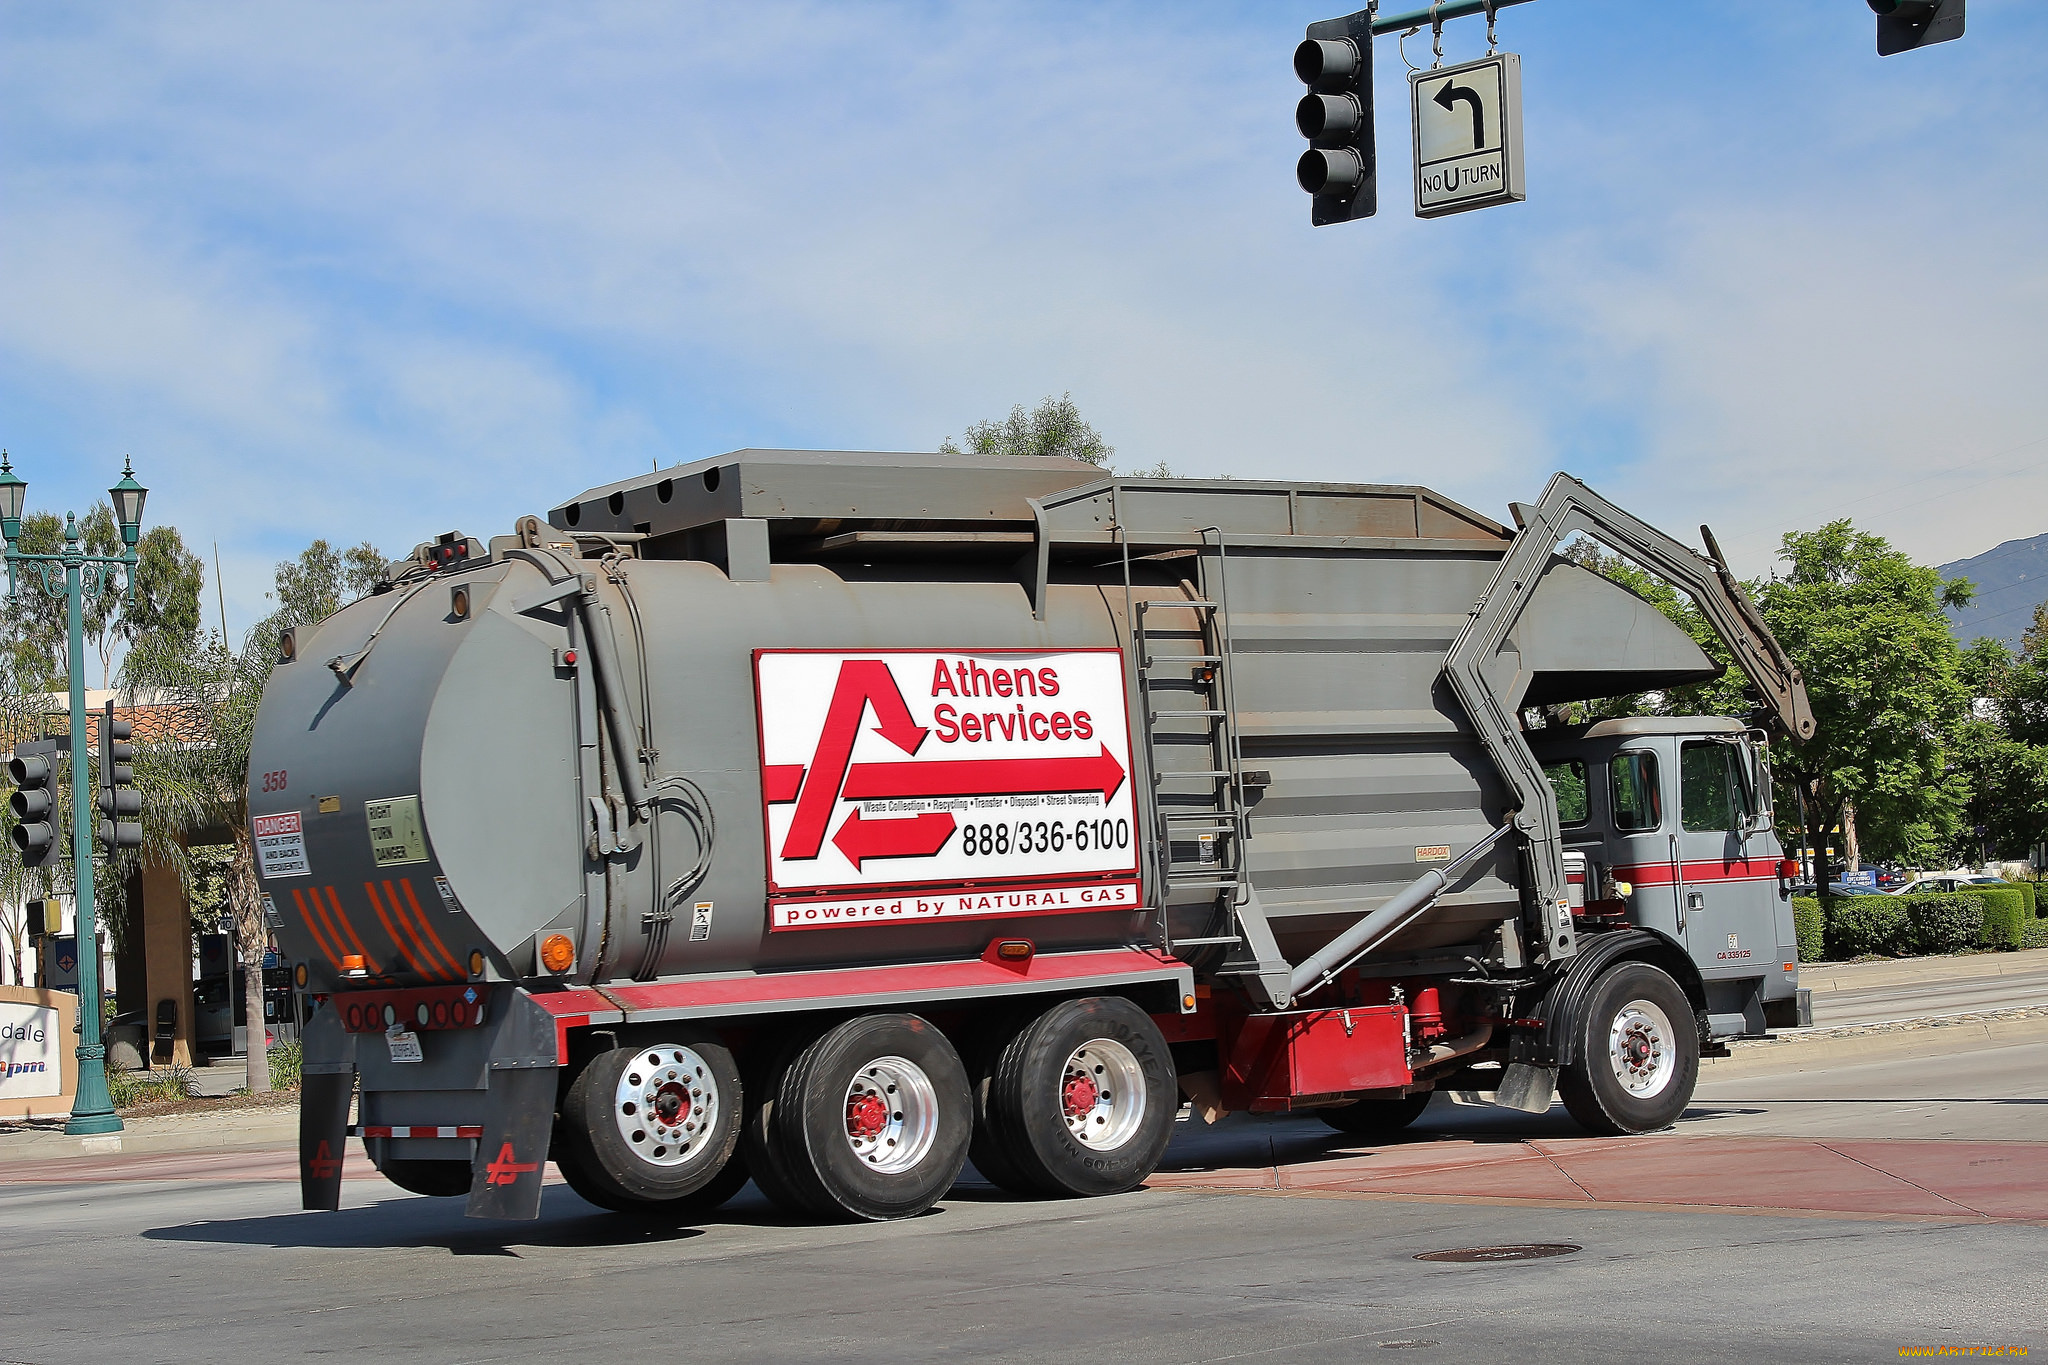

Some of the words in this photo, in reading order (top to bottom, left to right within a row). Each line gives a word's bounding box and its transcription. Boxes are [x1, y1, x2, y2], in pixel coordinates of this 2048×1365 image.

[1423, 175, 1442, 194] NO
[1443, 167, 1460, 193] U
[1461, 163, 1501, 186] TURN
[931, 658, 1060, 698] Athens
[934, 702, 1094, 744] Services
[262, 769, 288, 793] 358
[369, 804, 392, 820] RIGHT
[863, 801, 887, 813] Waste
[888, 800, 926, 812] Collection
[932, 798, 968, 812] Recycling
[974, 797, 1003, 808] Transfer
[1010, 795, 1040, 808] Disposal
[1046, 795, 1067, 806] Street
[1068, 793, 1100, 807] Sweeping
[257, 815, 300, 836] DANGER
[371, 826, 393, 841] TURN
[259, 836, 280, 848] TRUCK
[281, 835, 301, 847] STOPS
[962, 818, 1129, 857] 888/336-6100
[265, 849, 278, 860] AND
[279, 848, 300, 860] BACKS
[376, 845, 409, 861] DANGER
[1417, 847, 1449, 857] HARDOX
[265, 861, 305, 873] FREQUENTLY
[786, 900, 902, 924] powered
[917, 899, 945, 916] by
[959, 891, 1070, 911] NATURAL
[1081, 887, 1126, 903] GAS
[1717, 952, 1727, 960] CA
[1727, 949, 1751, 960] 335125
[1, 1022, 45, 1042] dale
